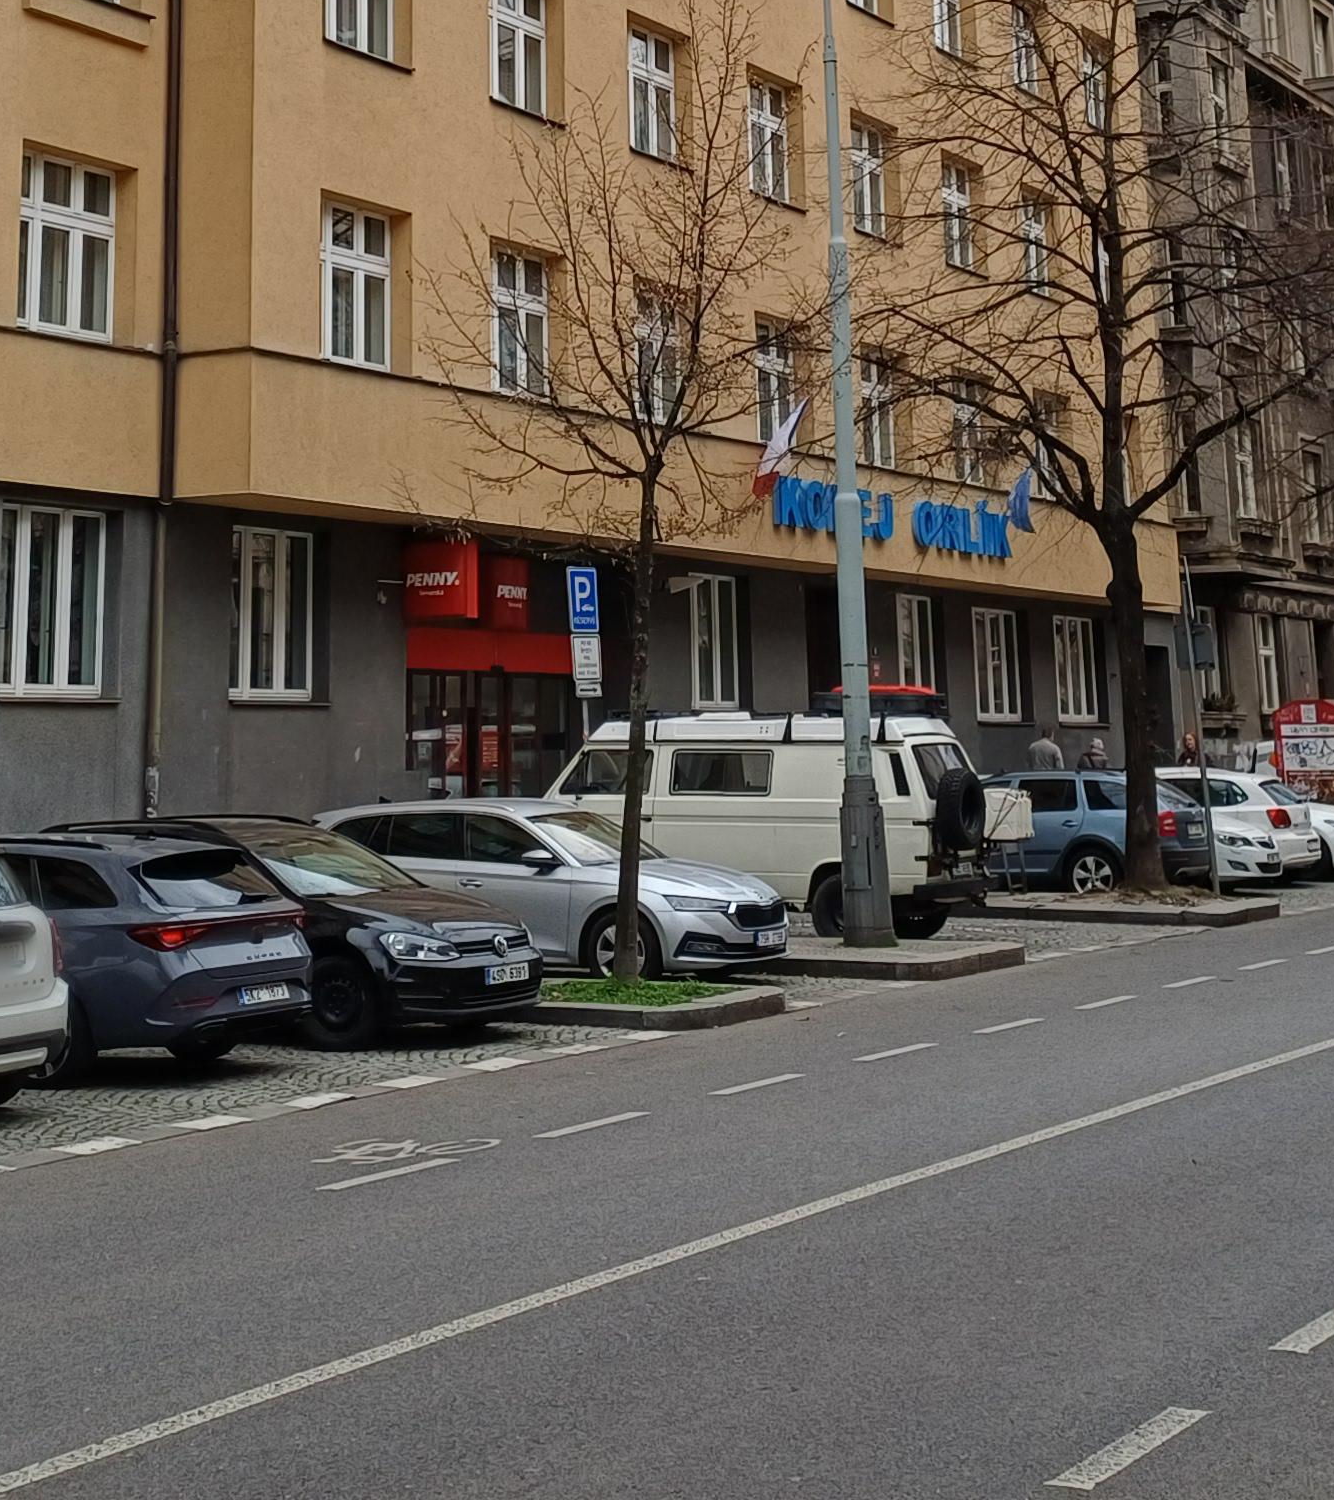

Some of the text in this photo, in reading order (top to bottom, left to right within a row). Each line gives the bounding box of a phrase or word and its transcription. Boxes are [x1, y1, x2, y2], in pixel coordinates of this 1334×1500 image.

[773, 475, 1012, 558] KOEJ ORLÍK
[574, 576, 591, 612] P
